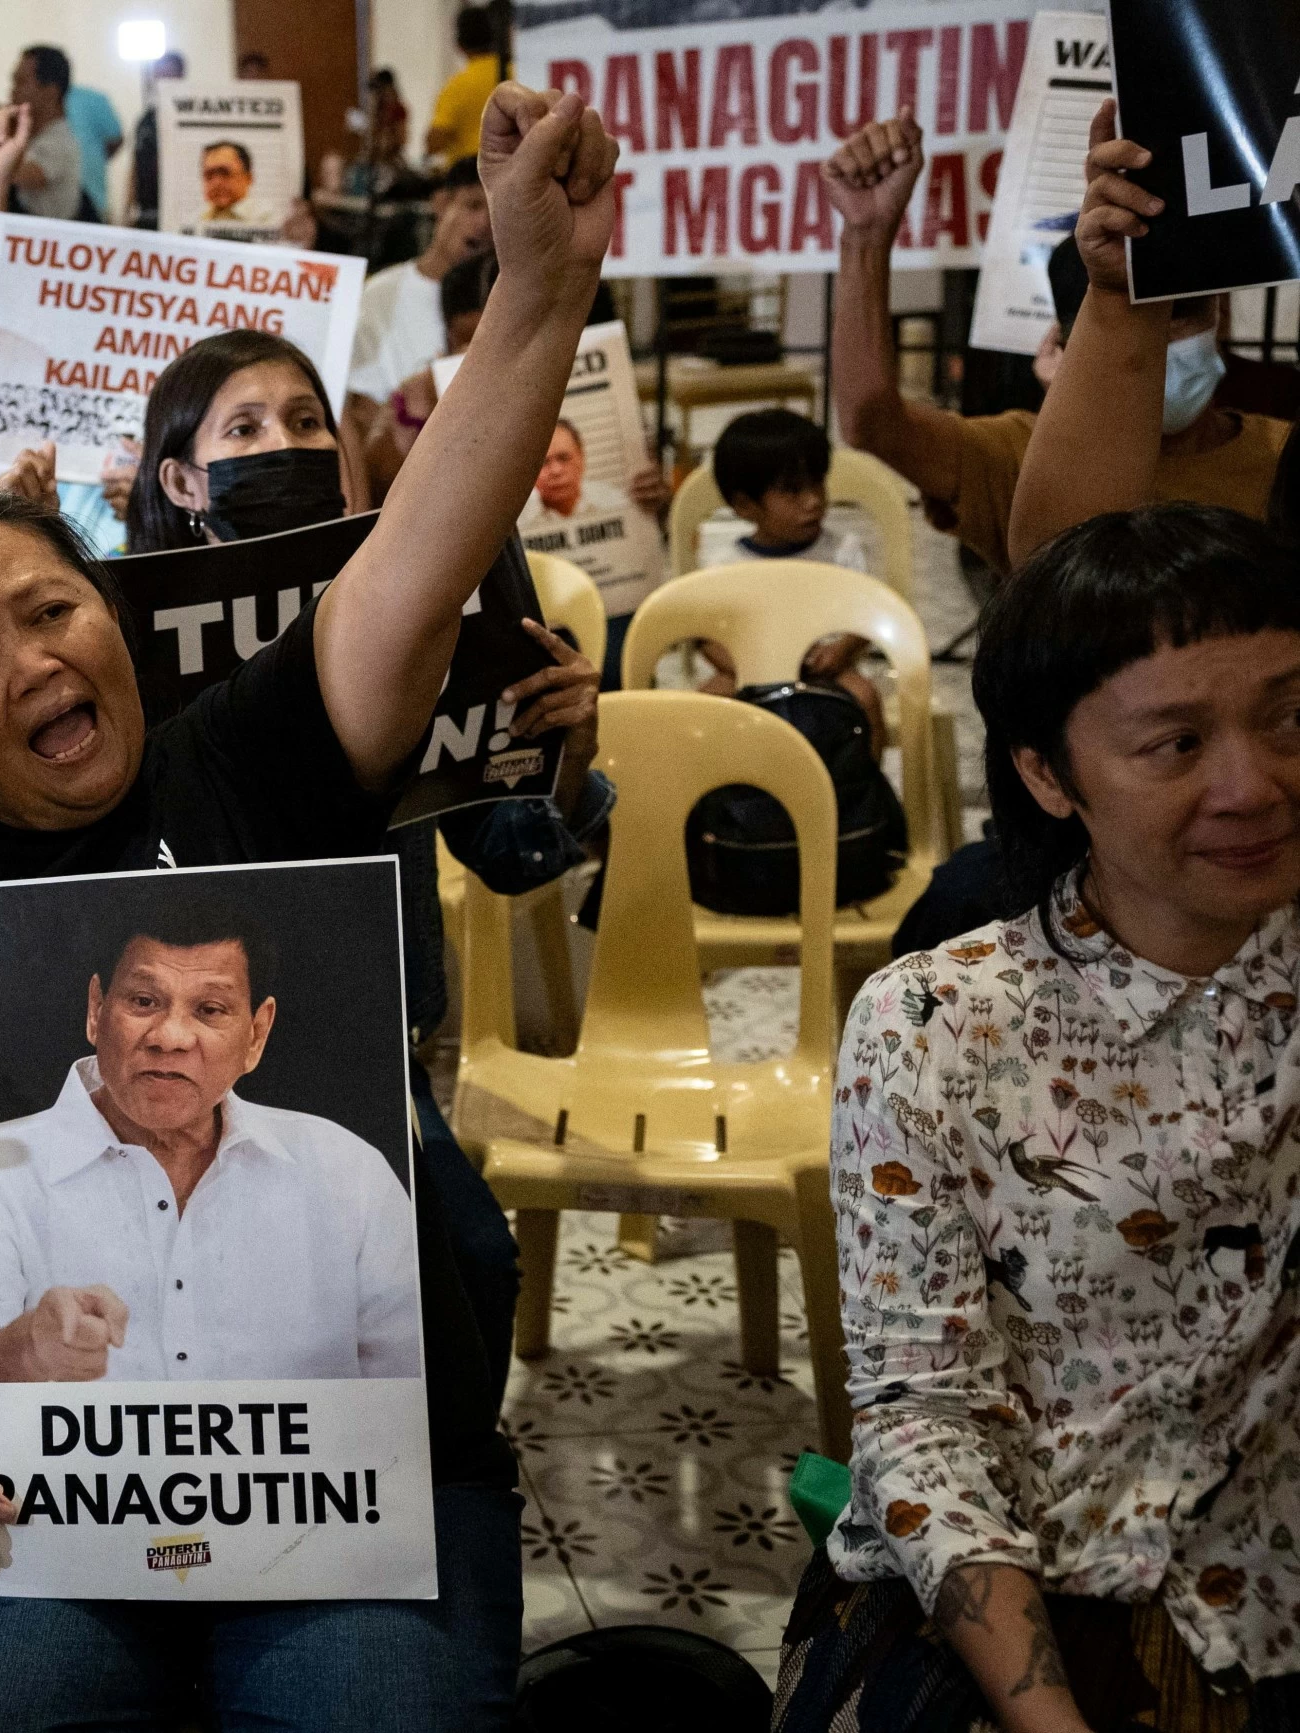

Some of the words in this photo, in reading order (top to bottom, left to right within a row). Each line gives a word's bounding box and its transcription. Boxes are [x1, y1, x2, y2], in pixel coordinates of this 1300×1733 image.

[173, 97, 285, 115] WANTED
[663, 161, 834, 258] MGA
[5, 235, 117, 275] TULOY
[121, 250, 197, 285] ANG
[206, 260, 333, 304] LABAN!
[39, 279, 199, 327] HUSTISYA
[206, 301, 284, 336] ANG
[41, 1403, 311, 1457] DUTERTE
[147, 1541, 210, 1557] DUTERTE
[152, 1551, 207, 1569] PANAGUTIN!
